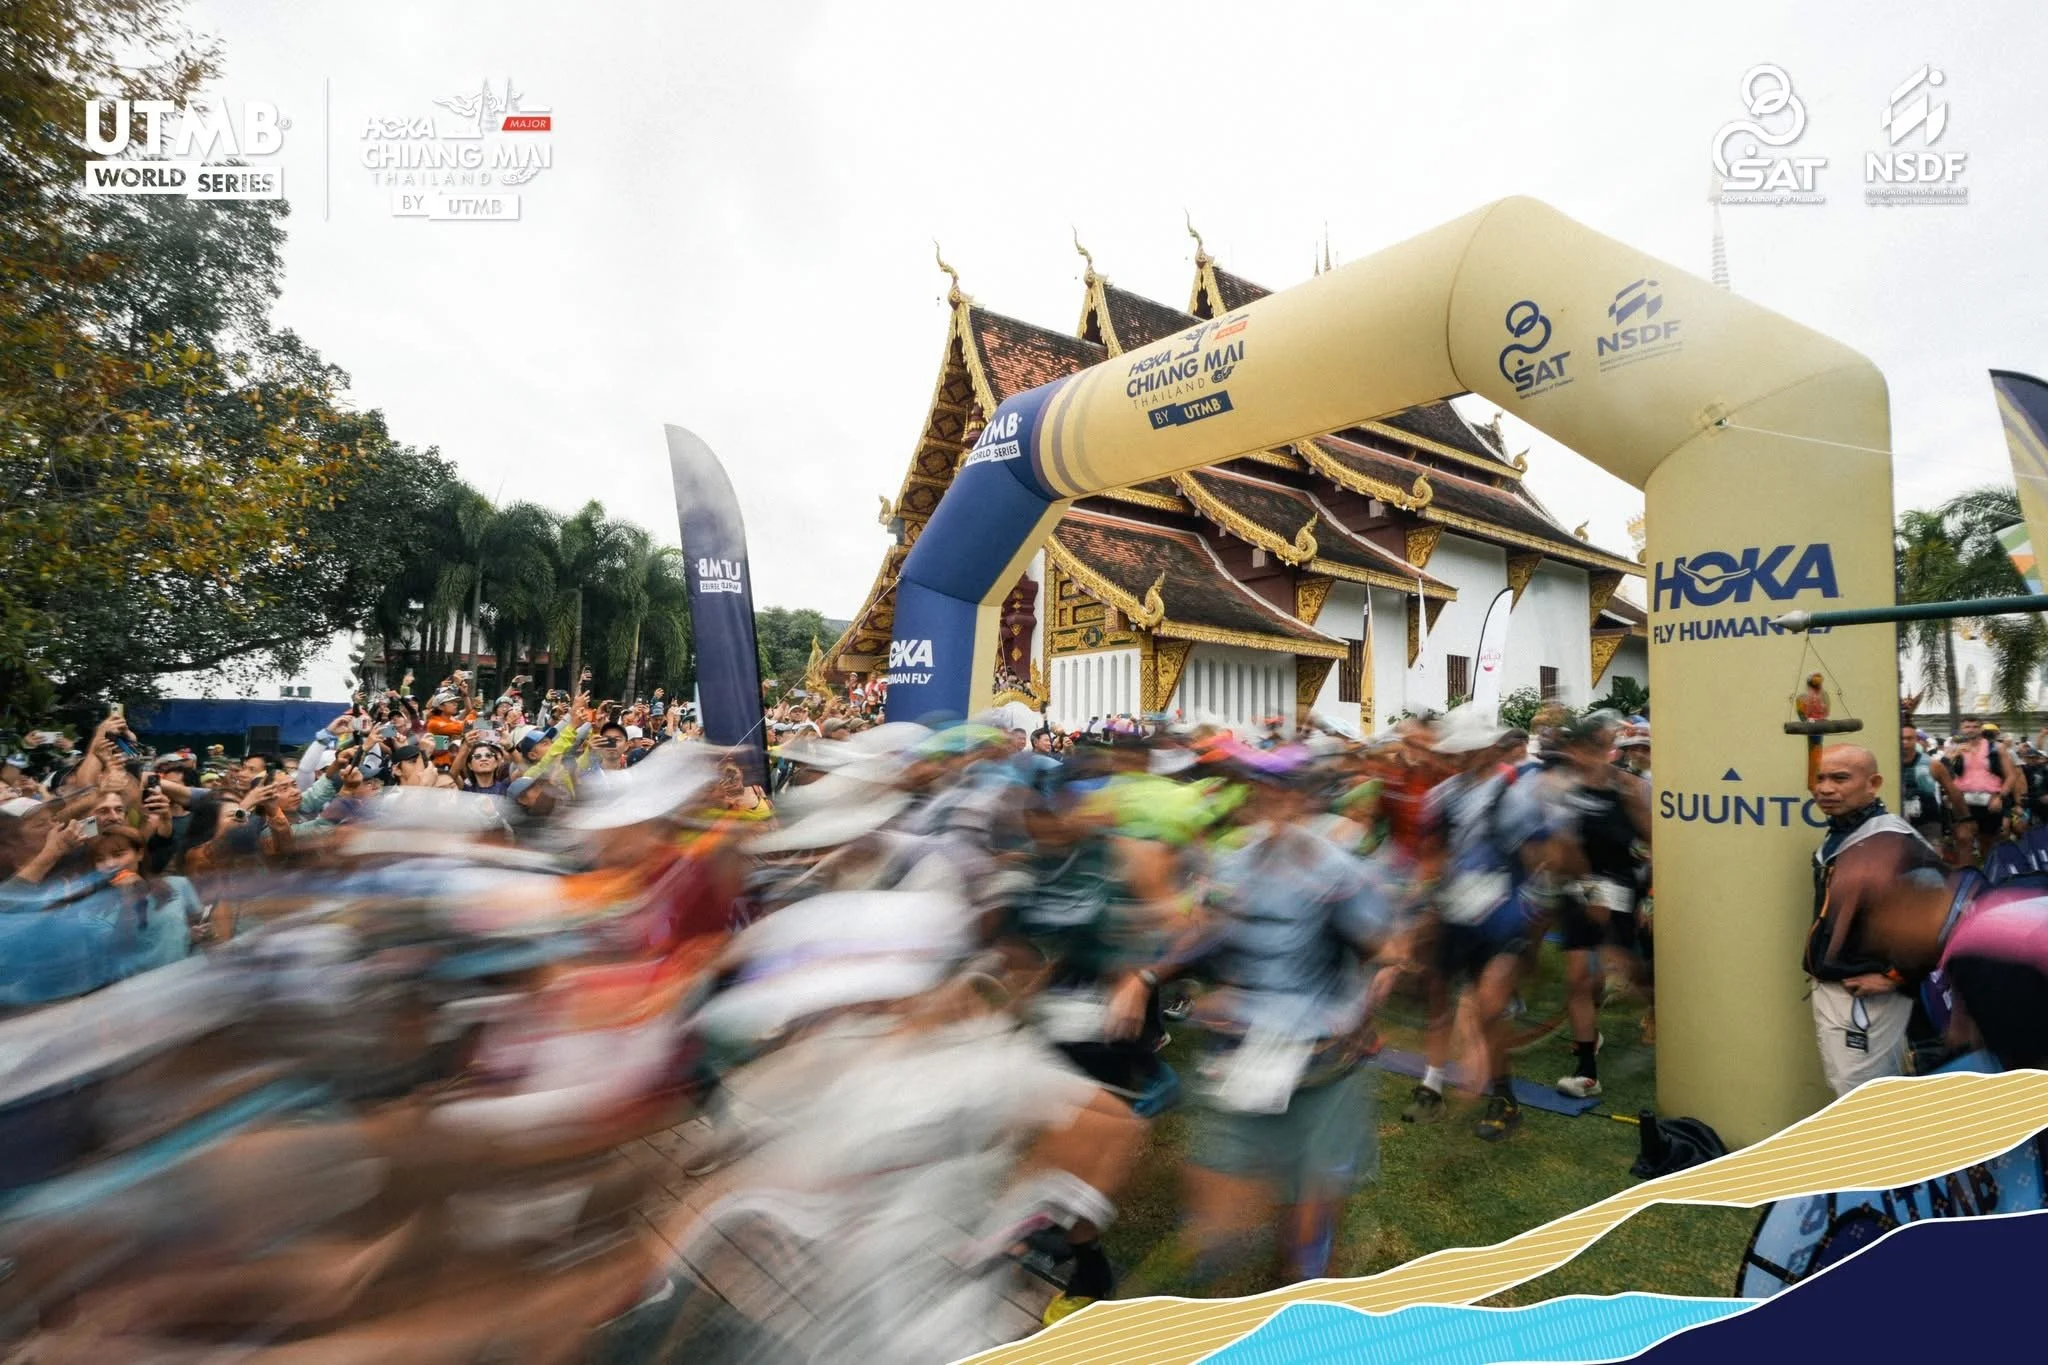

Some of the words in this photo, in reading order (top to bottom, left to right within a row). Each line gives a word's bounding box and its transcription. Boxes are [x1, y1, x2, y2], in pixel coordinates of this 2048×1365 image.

[1596, 320, 1682, 357] NSDF
[1126, 358, 1199, 398] CHIANG
[1203, 340, 1244, 373] MAI
[1127, 350, 1172, 377] HOKA
[1514, 350, 1571, 393] SAT
[1133, 378, 1206, 409] THAILAND
[1154, 410, 1170, 425] BY
[1183, 398, 1222, 420] UTMB
[994, 444, 1018, 458] SERIES
[1653, 543, 1839, 613] HOKA
[1653, 623, 1675, 645] FLY
[1679, 613, 1834, 642] HUMAN
[911, 673, 933, 685] FLY
